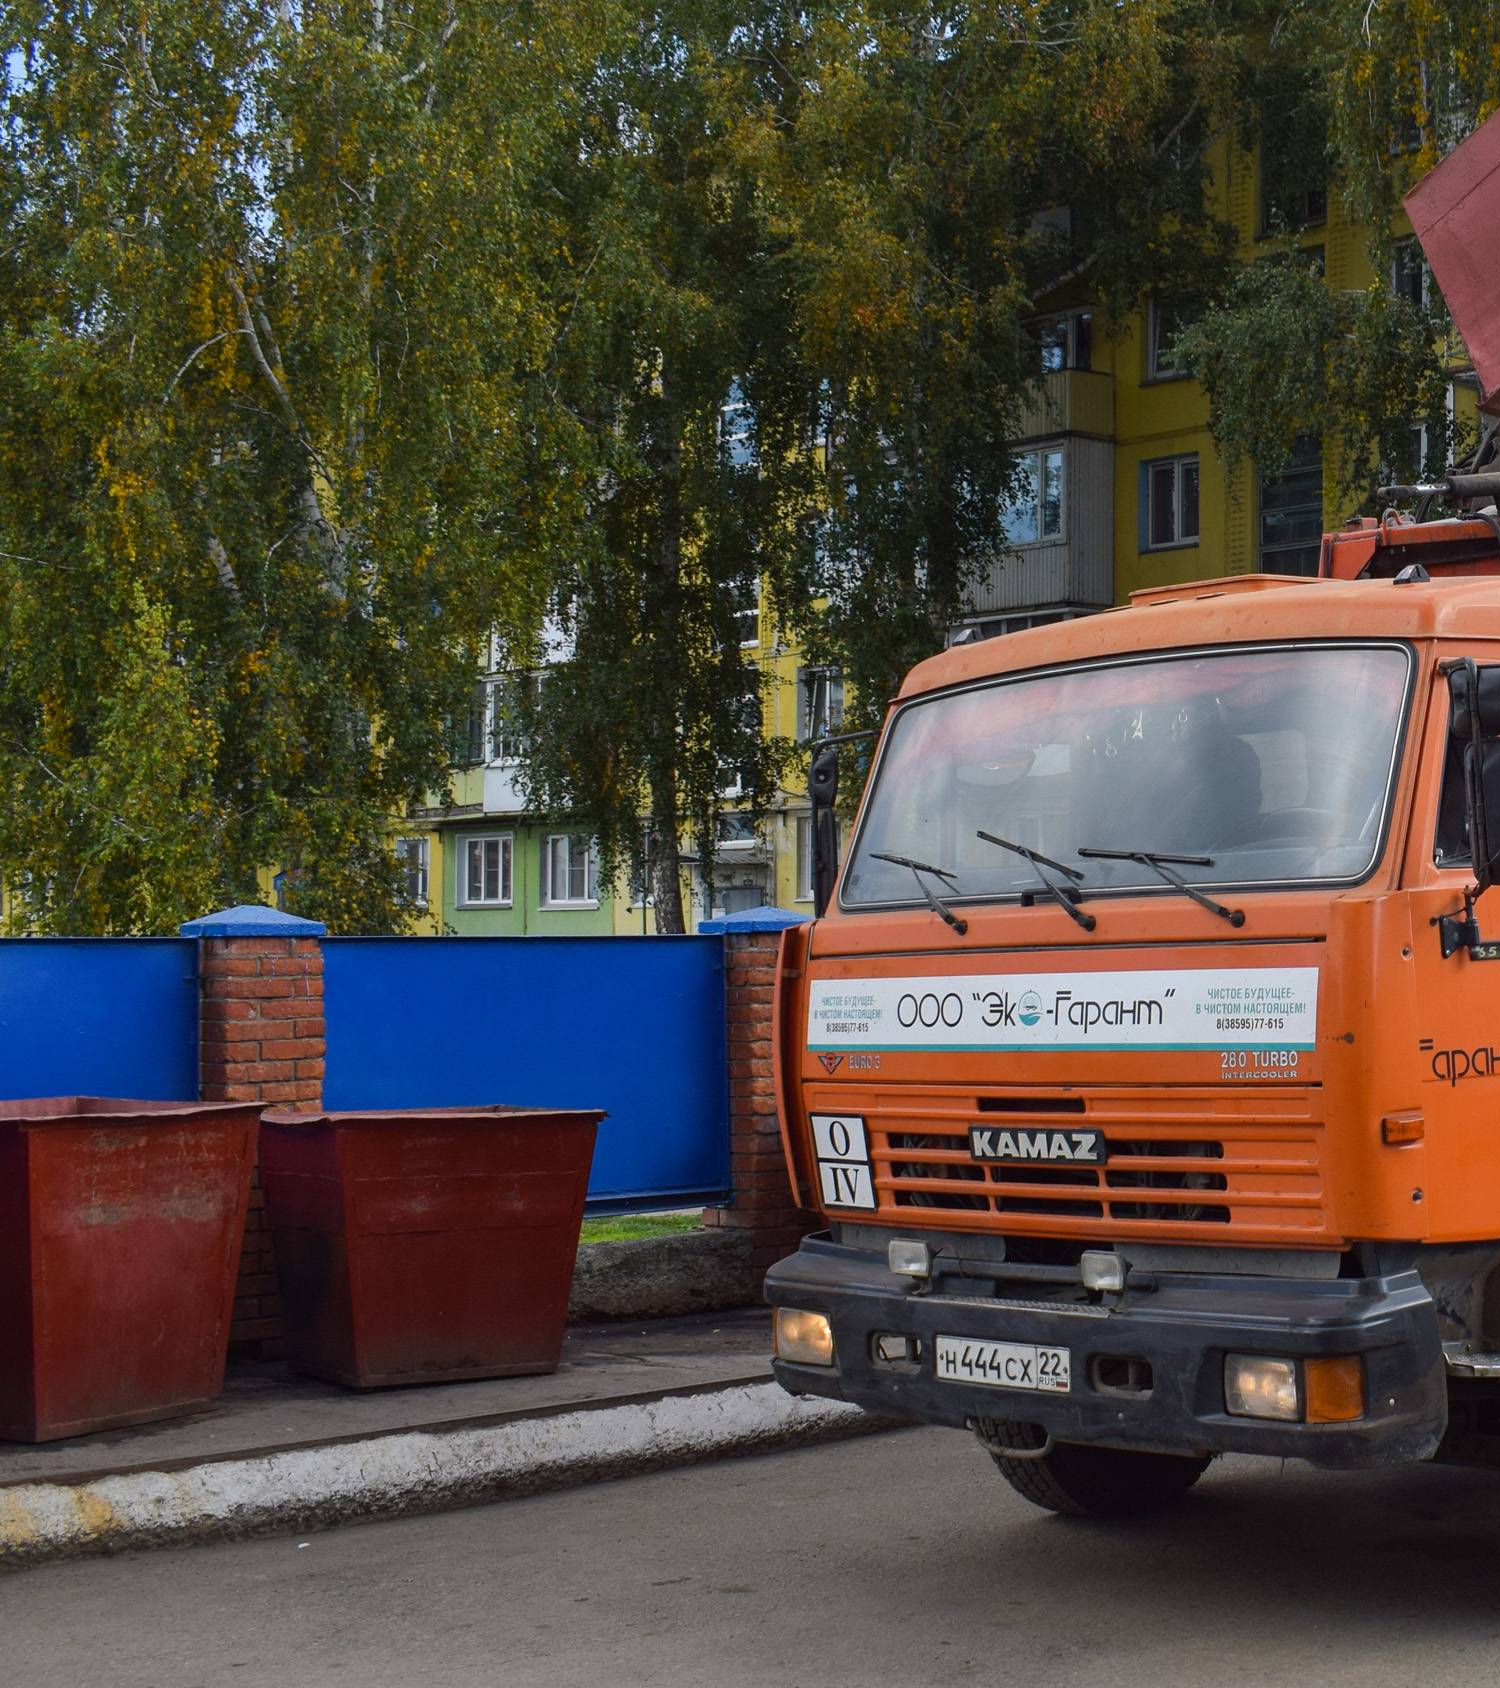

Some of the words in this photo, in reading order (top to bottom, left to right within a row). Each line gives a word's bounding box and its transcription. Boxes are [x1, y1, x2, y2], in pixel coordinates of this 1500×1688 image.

[1207, 988, 1242, 1000] ЧИСТОЕ
[819, 1010, 842, 1019] ЧИСТОМ
[897, 992, 963, 1028] ООО
[1196, 1004, 1201, 1015] В
[1204, 1003, 1240, 1015] ЧИСТОМ
[1244, 1002, 1306, 1016] НАСТОЯЩЕМ!
[826, 1022, 869, 1034] 8(38595)77-615
[1216, 1018, 1284, 1031] 8(38595)77-615
[848, 1055, 872, 1069] EURO
[874, 1055, 881, 1069] 3
[1221, 1052, 1246, 1068] 280
[1252, 1051, 1298, 1067] TURBO
[1221, 1070, 1297, 1079] INTERCOOLER
[972, 1131, 1098, 1160] KAMAZ
[829, 1167, 860, 1204] IV
[1039, 1352, 1061, 1376] 22
[1039, 1376, 1056, 1387] RUS
